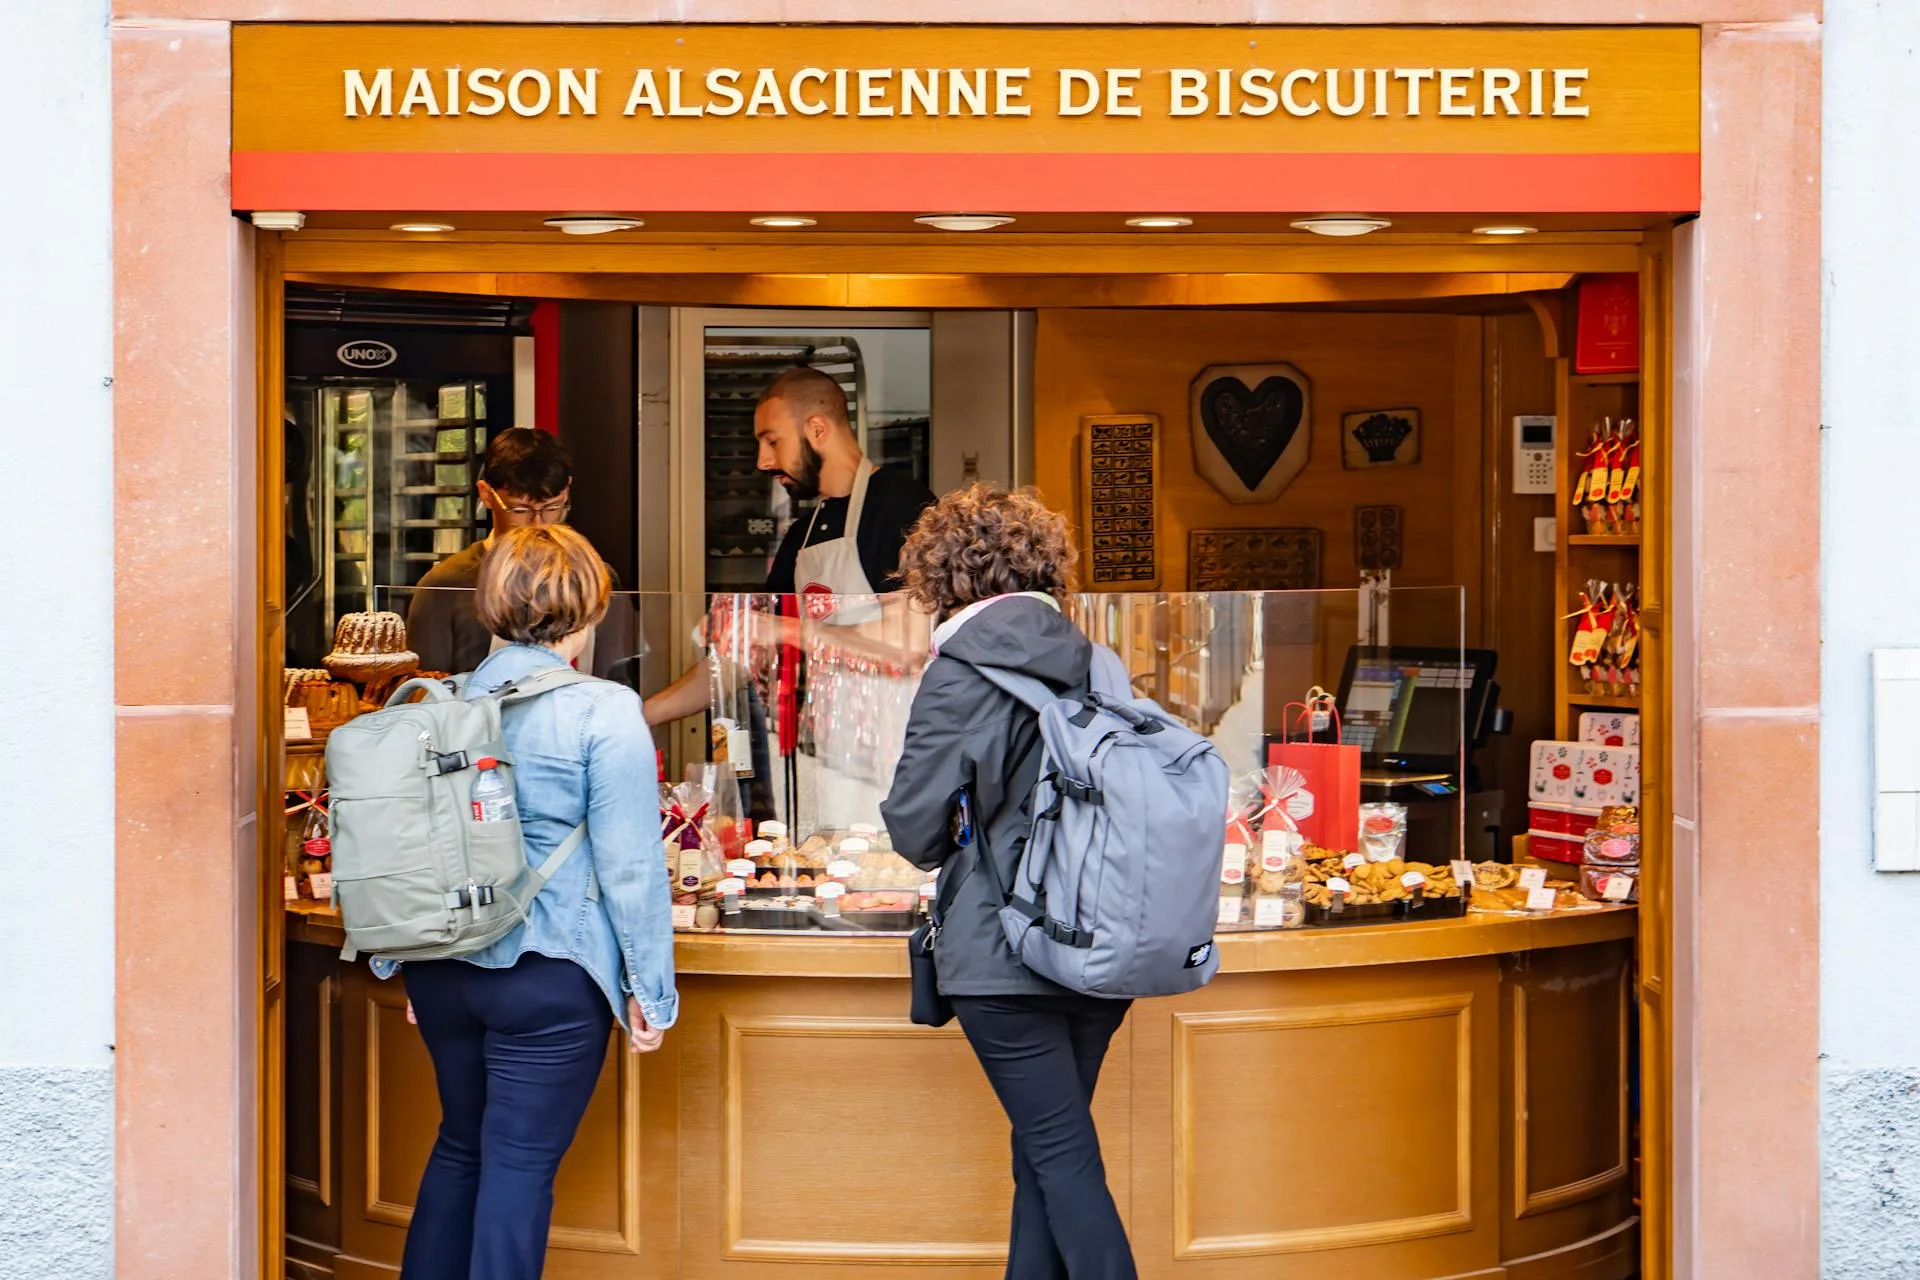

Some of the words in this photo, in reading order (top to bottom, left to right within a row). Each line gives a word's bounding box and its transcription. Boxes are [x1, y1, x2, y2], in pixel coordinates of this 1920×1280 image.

[344, 67, 598, 116] MAISON
[623, 67, 1031, 116] ALSACIENNE
[1058, 67, 1141, 116] DE
[1169, 67, 1590, 116] BISCUITERIE
[344, 348, 387, 360] UNOX
